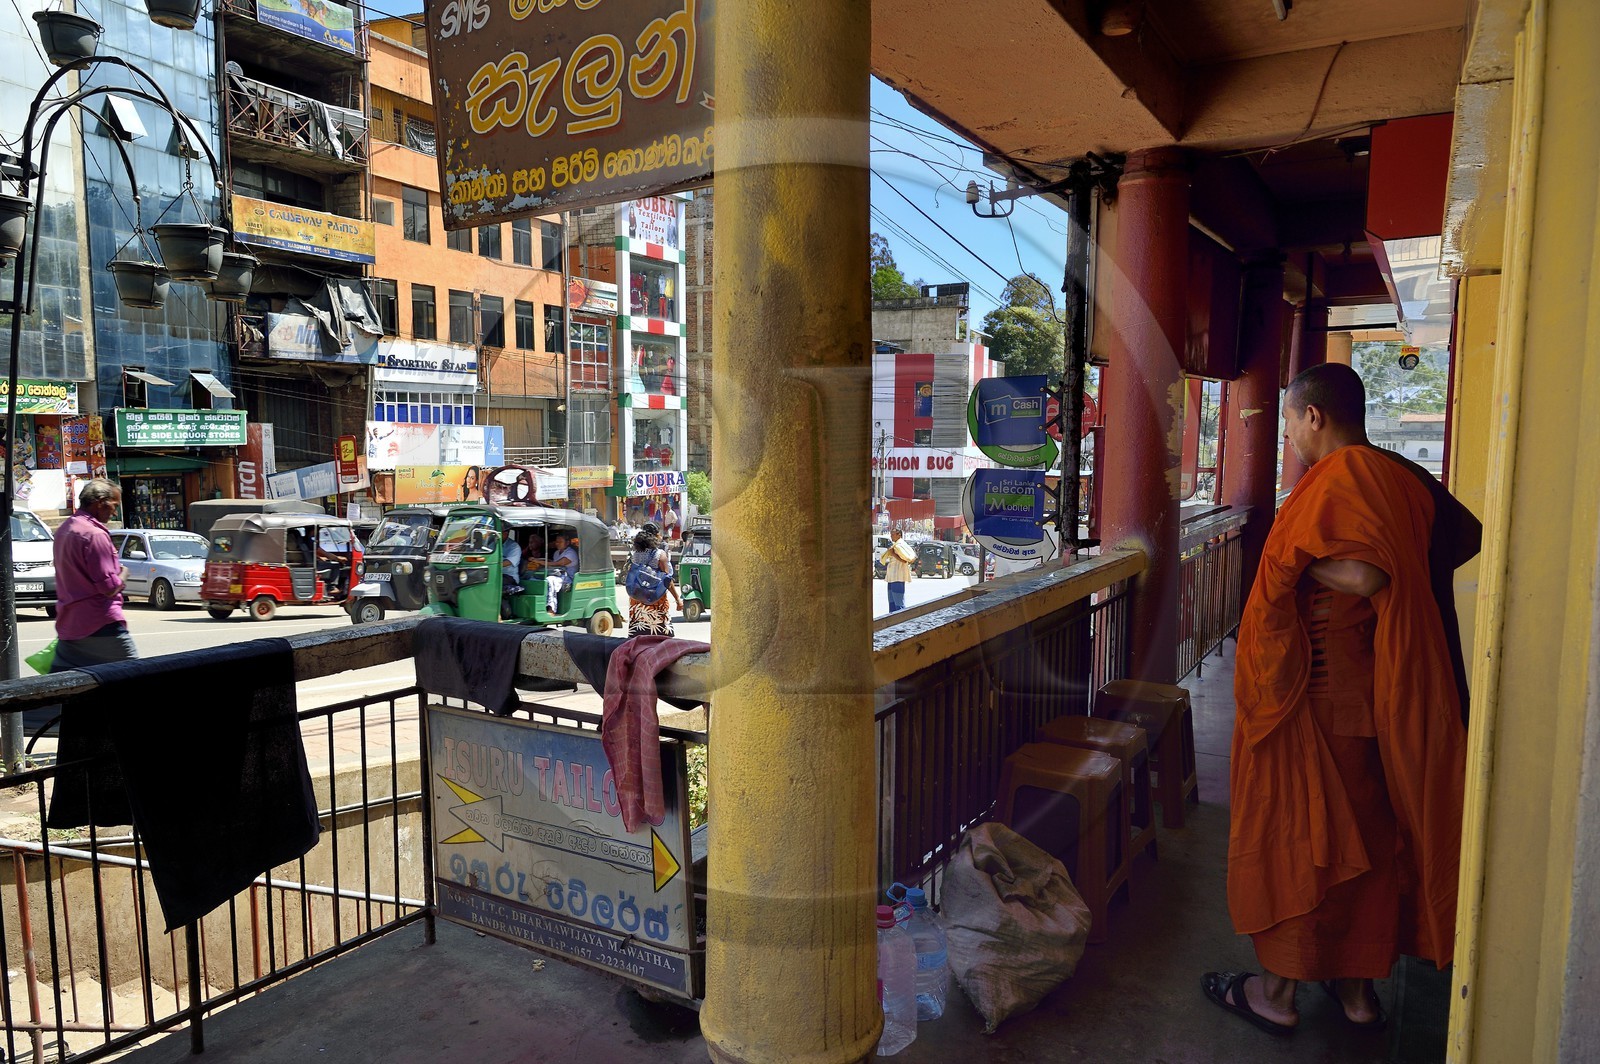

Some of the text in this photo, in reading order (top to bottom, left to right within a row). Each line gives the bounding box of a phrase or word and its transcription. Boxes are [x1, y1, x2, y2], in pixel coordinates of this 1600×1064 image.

[440, 0, 490, 38] SMS
[512, 167, 546, 193] සහ
[636, 197, 676, 218] SUBRA
[638, 208, 666, 222] Textiles
[269, 209, 322, 227] CAUSEWAY
[641, 221, 665, 234] Tailors
[1012, 399, 1038, 410] Cash
[208, 431, 240, 439] STORES
[872, 456, 919, 470] ASHION
[927, 456, 954, 470] BUG
[636, 471, 686, 488] SUBRA
[627, 486, 655, 497] Textiles
[985, 481, 1035, 495] Telecom
[989, 498, 1031, 511] Mobitel
[443, 737, 524, 797] ISURU
[471, 912, 544, 945] BANDRAWELA
[512, 910, 604, 948] DHARMAWIJAYA
